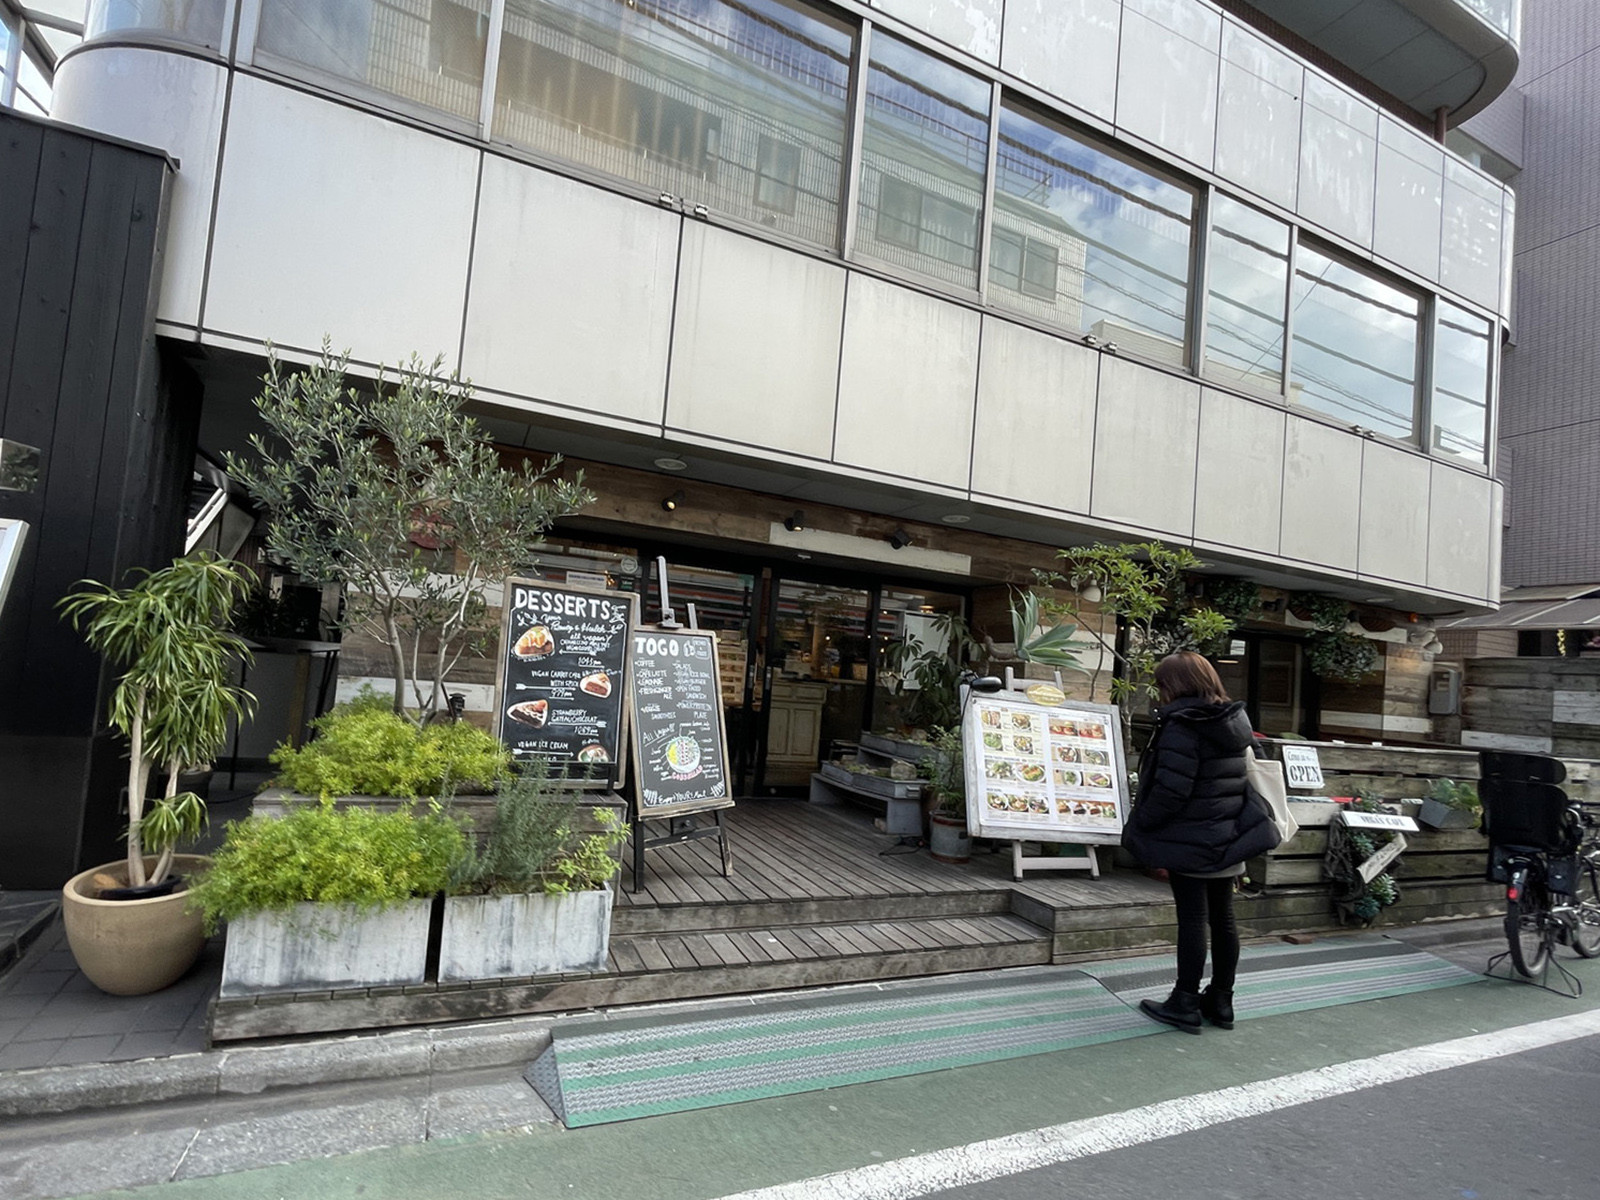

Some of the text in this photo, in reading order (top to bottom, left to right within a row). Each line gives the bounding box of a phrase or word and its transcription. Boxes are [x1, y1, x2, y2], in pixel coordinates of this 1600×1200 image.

[515, 588, 611, 620] DESSERTS
[634, 637, 680, 656] TOGO
[549, 741, 569, 749] CREAM
[1290, 765, 1320, 782] OPEN
